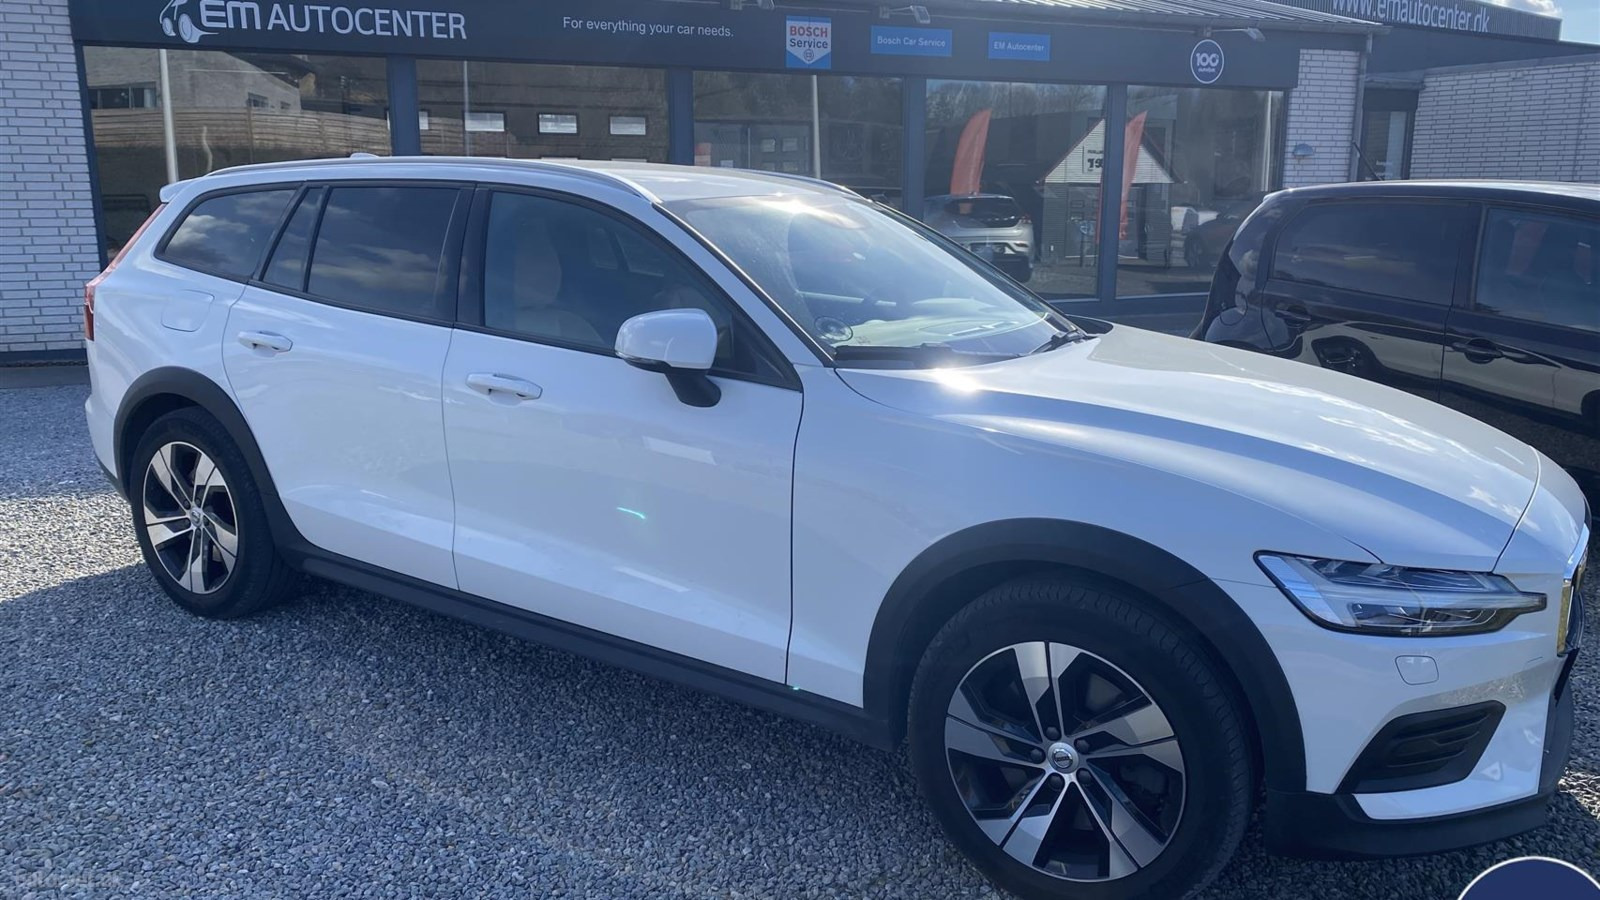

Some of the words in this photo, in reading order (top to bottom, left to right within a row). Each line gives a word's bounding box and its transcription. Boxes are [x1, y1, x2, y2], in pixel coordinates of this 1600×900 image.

[267, 3, 467, 40] AUTOCENTER
[563, 16, 583, 29] For
[586, 19, 646, 35] everything
[649, 23, 674, 36] your
[677, 25, 694, 35] car
[697, 25, 734, 37] needs.
[789, 25, 828, 38] BOSCH
[789, 38, 828, 49] Service
[877, 35, 901, 45] Bosch
[903, 37, 917, 46] Car
[918, 37, 946, 47] Service
[993, 41, 1006, 49] EM
[1007, 42, 1045, 52] Autocenter
